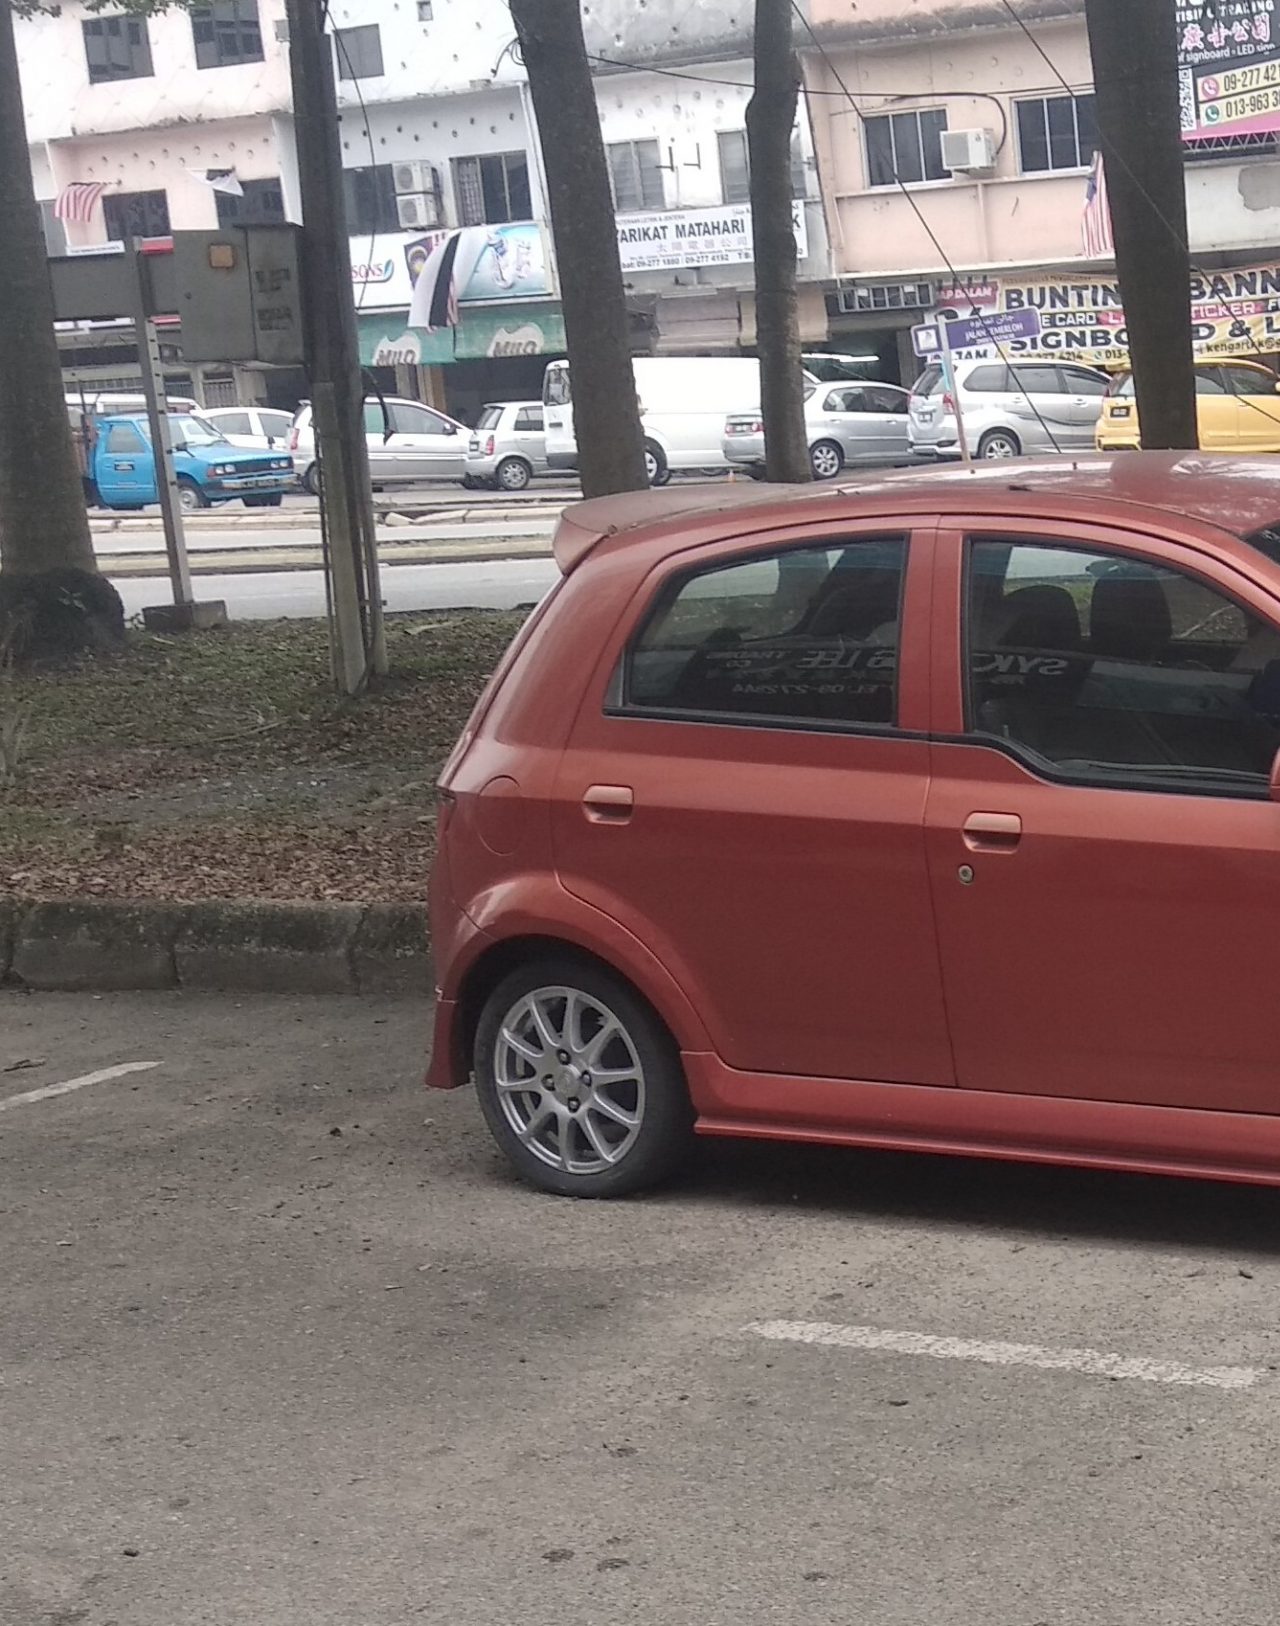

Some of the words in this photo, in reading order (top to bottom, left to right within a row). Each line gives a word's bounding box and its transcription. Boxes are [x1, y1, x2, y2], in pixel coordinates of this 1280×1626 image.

[1236, 44, 1255, 56] LED
[1223, 68, 1261, 92] 09-277
[1226, 93, 1270, 118] 013-963
[675, 219, 745, 237] MATAHARI
[1056, 312, 1096, 326] CARD
[965, 327, 987, 341] JALAN
[1228, 320, 1252, 338] &
[493, 340, 538, 356] MILO
[377, 349, 417, 365] MILO
